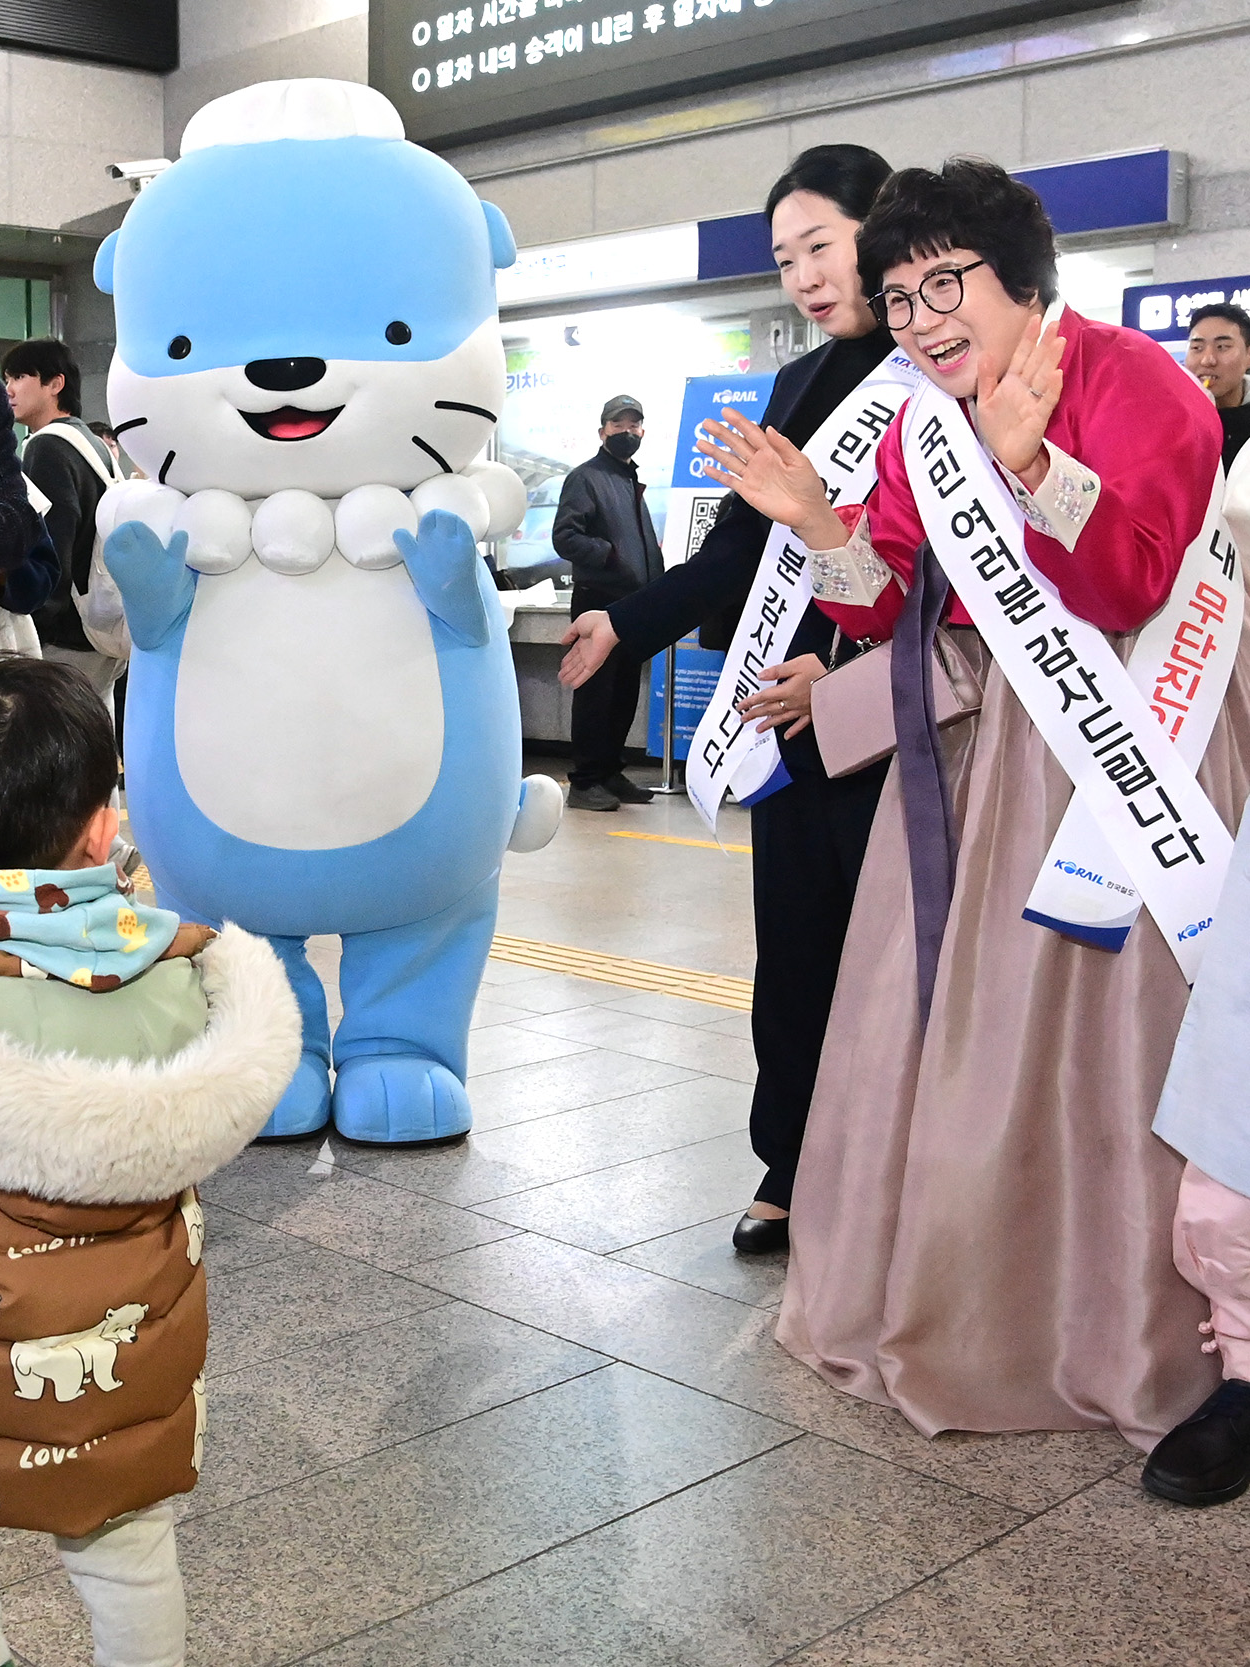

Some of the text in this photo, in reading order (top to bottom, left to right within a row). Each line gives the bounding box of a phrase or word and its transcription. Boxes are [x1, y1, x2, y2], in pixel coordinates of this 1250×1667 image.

[436, 7, 474, 42] 열차
[436, 54, 474, 88] 열차
[479, 42, 517, 75] 내의
[524, 24, 583, 65] 승객이
[591, 11, 634, 45] 내린
[642, 4, 666, 34] 후
[712, 389, 758, 404] KORAIL
[830, 401, 896, 474] 국민
[1209, 528, 1237, 581] 내
[918, 415, 1206, 870] 국민 여러분 감사드립니다
[1054, 859, 1104, 885] KORAIL
[1106, 880, 1135, 898] 한국철도
[1177, 917, 1213, 942] KORA
